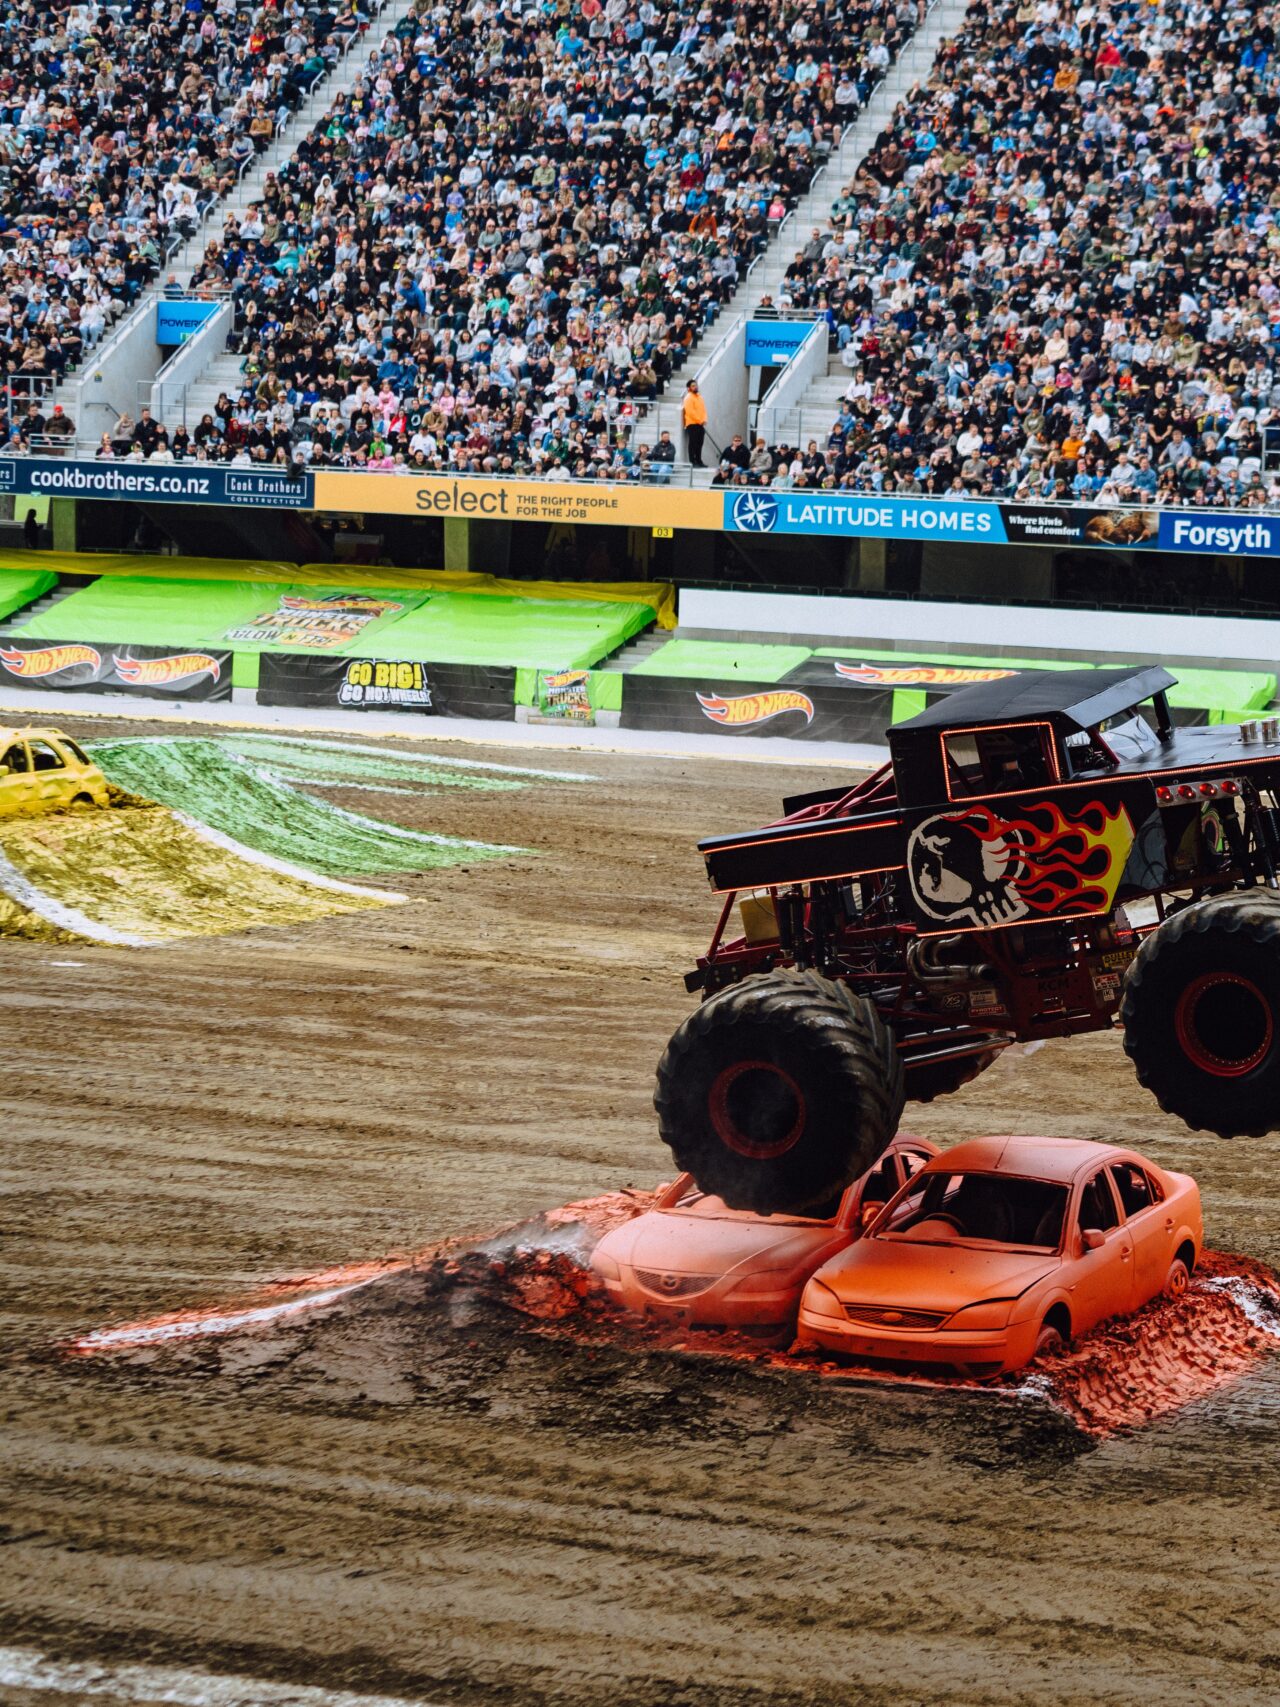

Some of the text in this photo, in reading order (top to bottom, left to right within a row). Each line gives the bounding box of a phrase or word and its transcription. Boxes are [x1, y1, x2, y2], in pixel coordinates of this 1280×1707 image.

[160, 319, 202, 328] POWER
[31, 468, 209, 494] cookbrothers.co.nz
[230, 477, 301, 494] Cook Brothers
[230, 496, 301, 505] CONSTRUCTION
[416, 481, 508, 514] select
[516, 495, 618, 508] THE RIGHT PEOPLE
[516, 507, 587, 518] FOR THE JOB
[787, 505, 991, 532] LATITUDE HOMES
[1009, 515, 1063, 527] Where Kiwis
[656, 528, 669, 537] 03
[1025, 525, 1080, 536] find comfort
[1174, 520, 1271, 552] Forsyth
[251, 614, 368, 633] TRUCKS
[233, 630, 282, 641] GLOW
[349, 663, 422, 690] GO BIG!
[341, 684, 363, 702] GO
[365, 686, 389, 701] HOT
